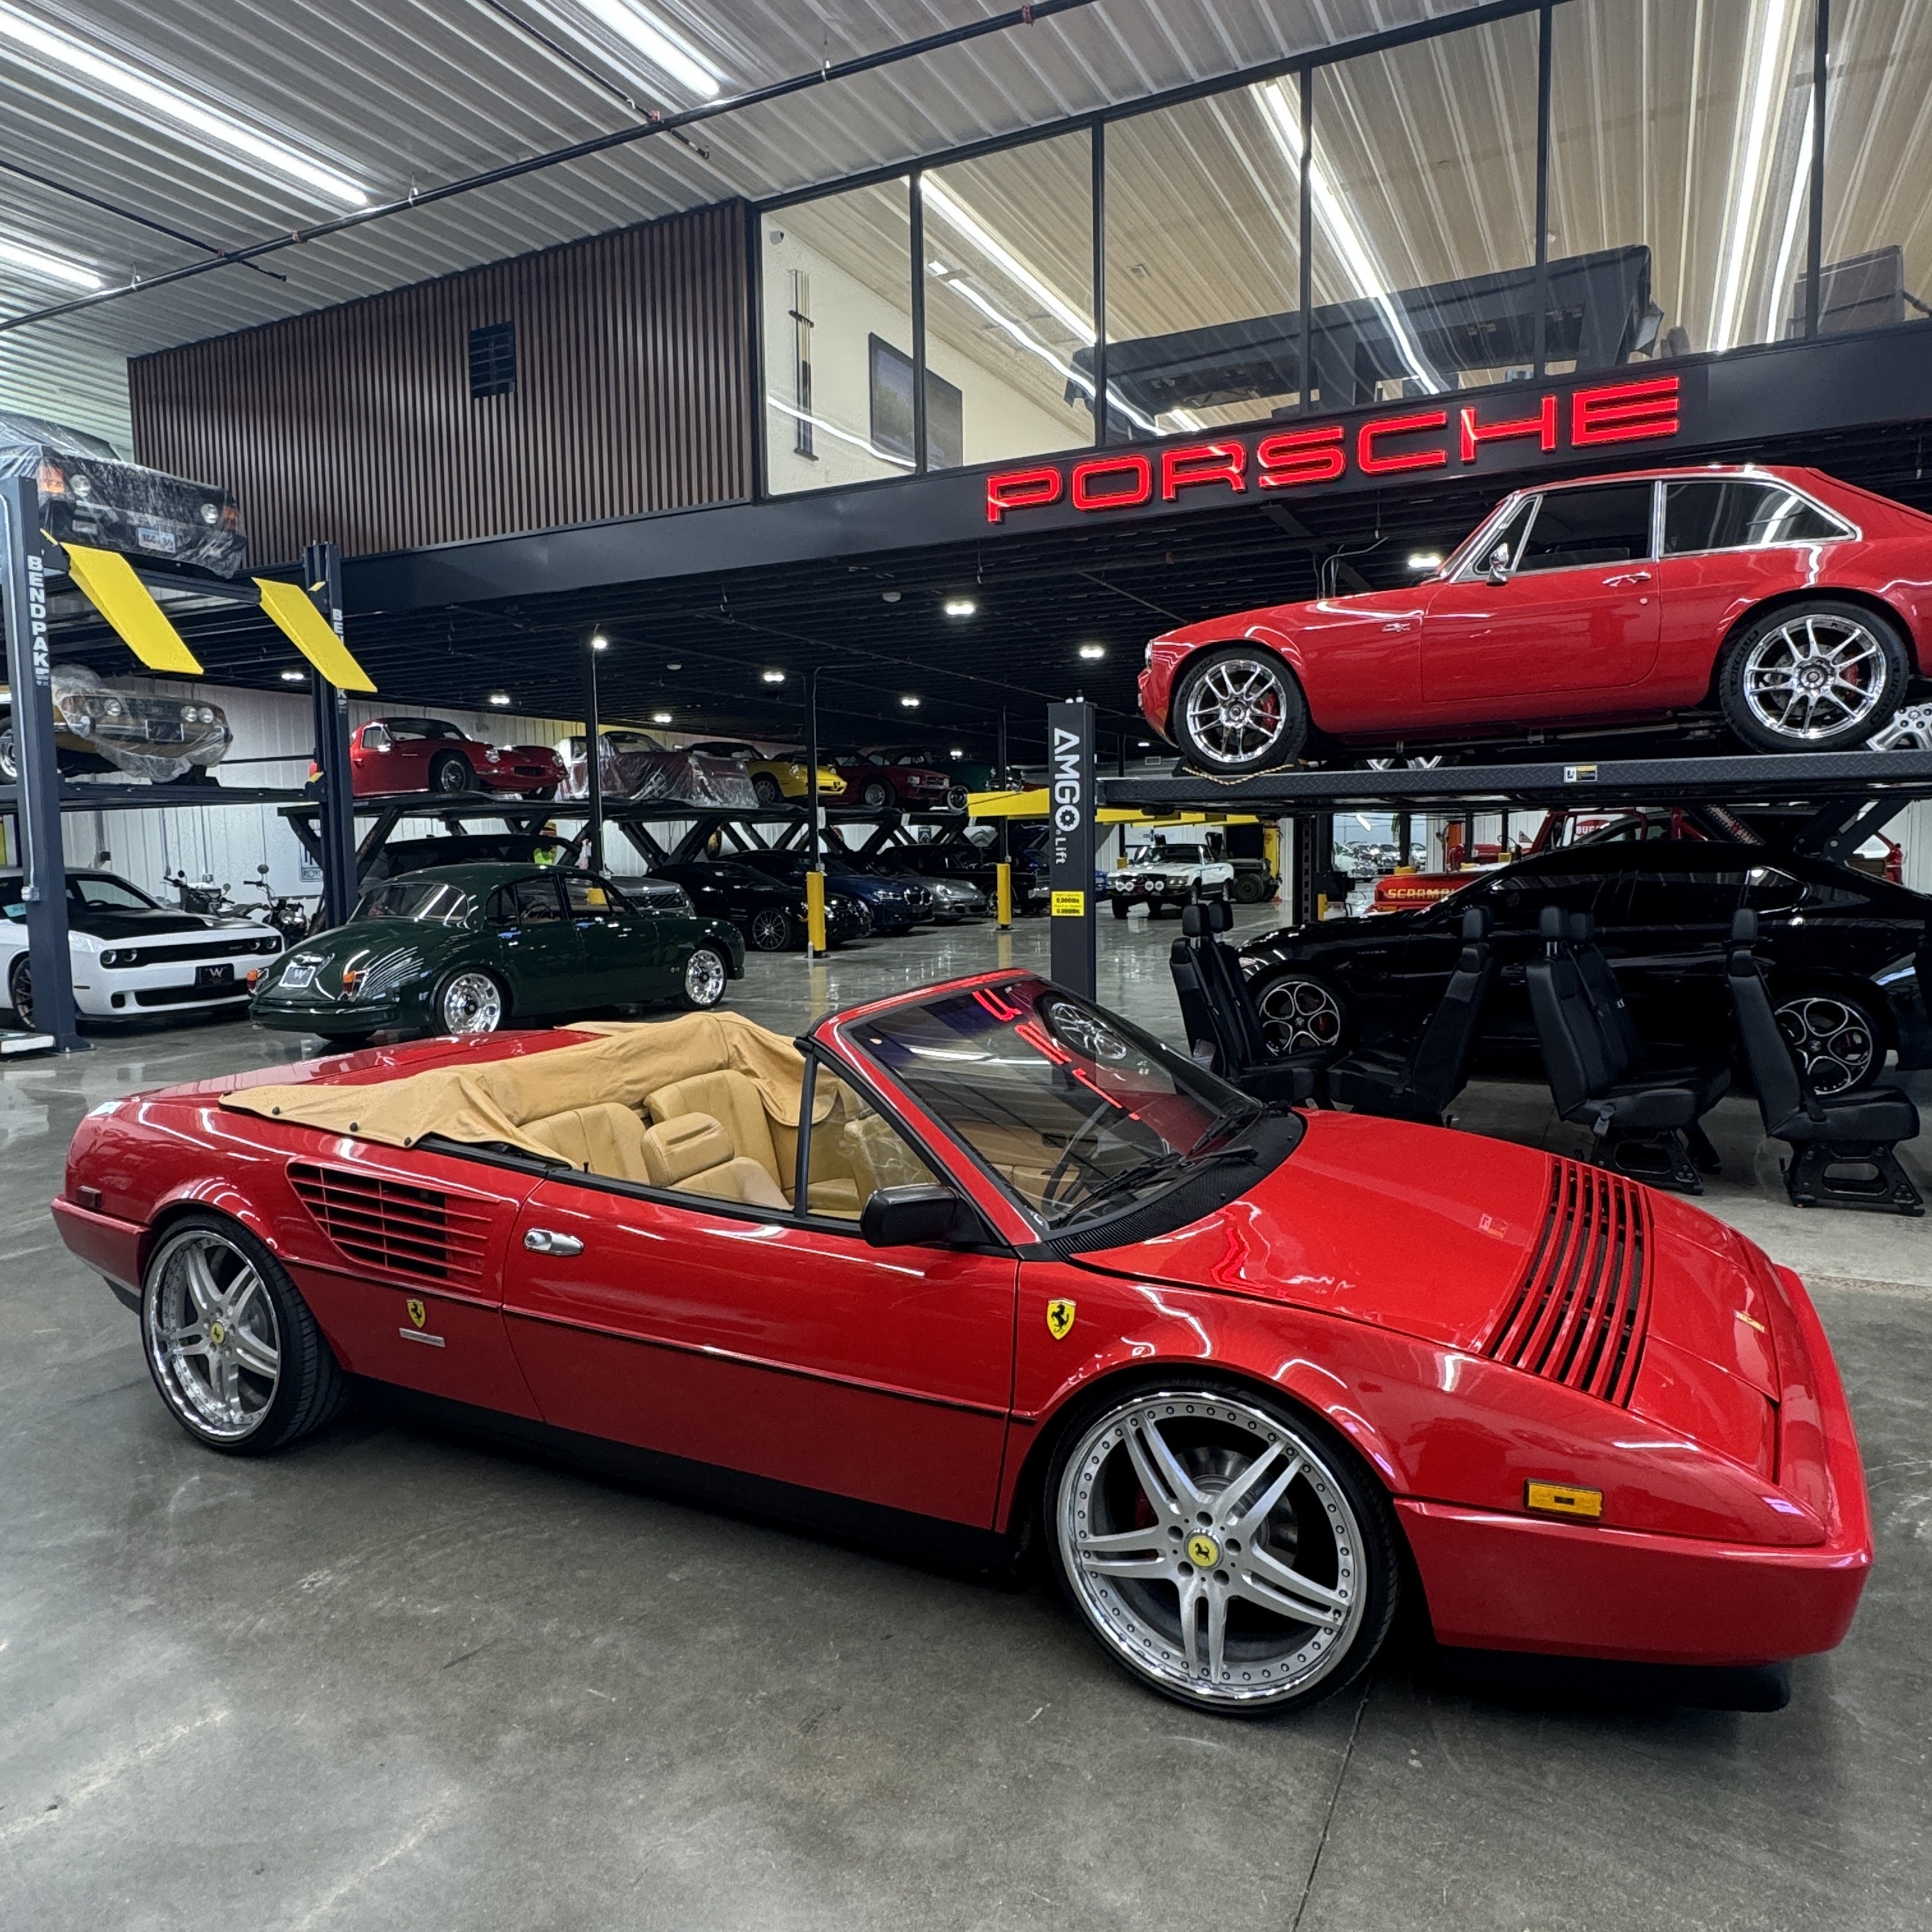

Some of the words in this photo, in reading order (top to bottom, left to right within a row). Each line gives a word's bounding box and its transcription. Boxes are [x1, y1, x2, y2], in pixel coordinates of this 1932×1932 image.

[986, 376, 1681, 524] PORSCHE
[27, 555, 49, 668] BENDPAK
[1054, 727, 1080, 832] AMGO
[1055, 837, 1067, 864] Lift
